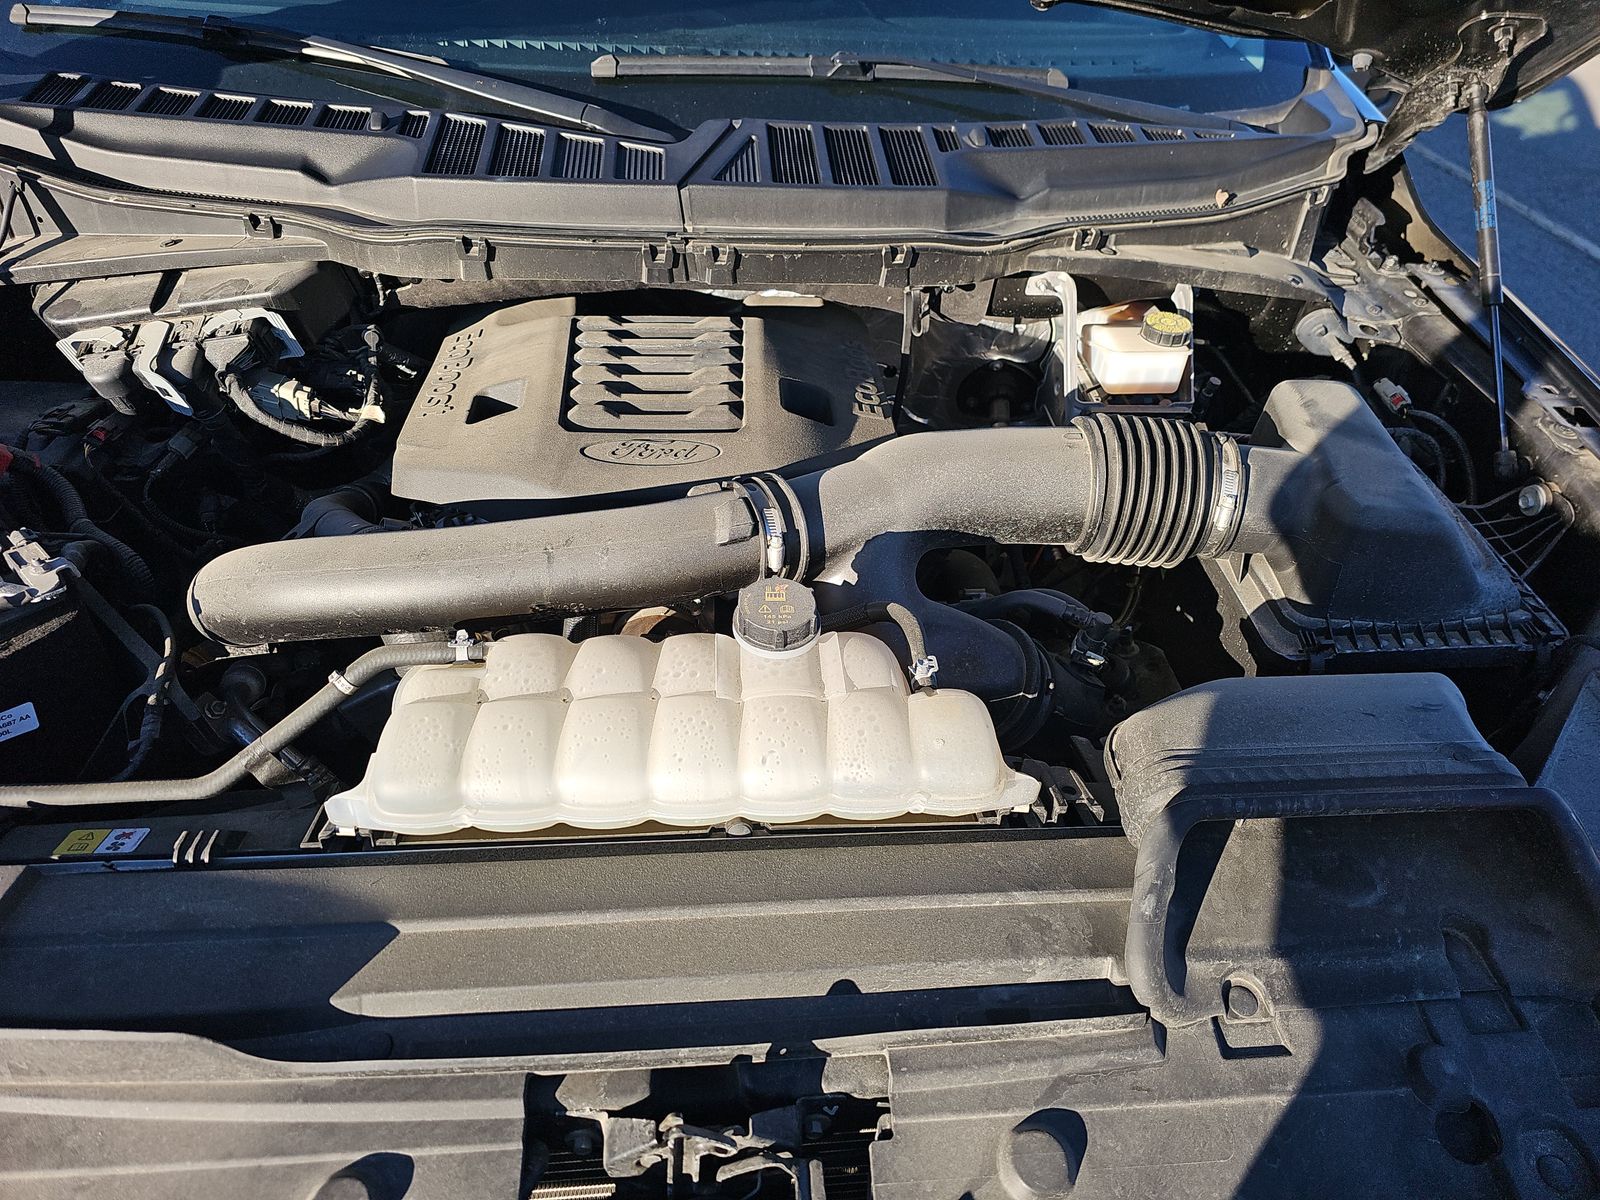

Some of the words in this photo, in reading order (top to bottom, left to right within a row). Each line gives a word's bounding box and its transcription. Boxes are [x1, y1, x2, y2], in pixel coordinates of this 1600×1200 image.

[416, 328, 484, 418] ECOBOOST
[607, 439, 701, 460] Ford
[19, 713, 31, 722] AA
